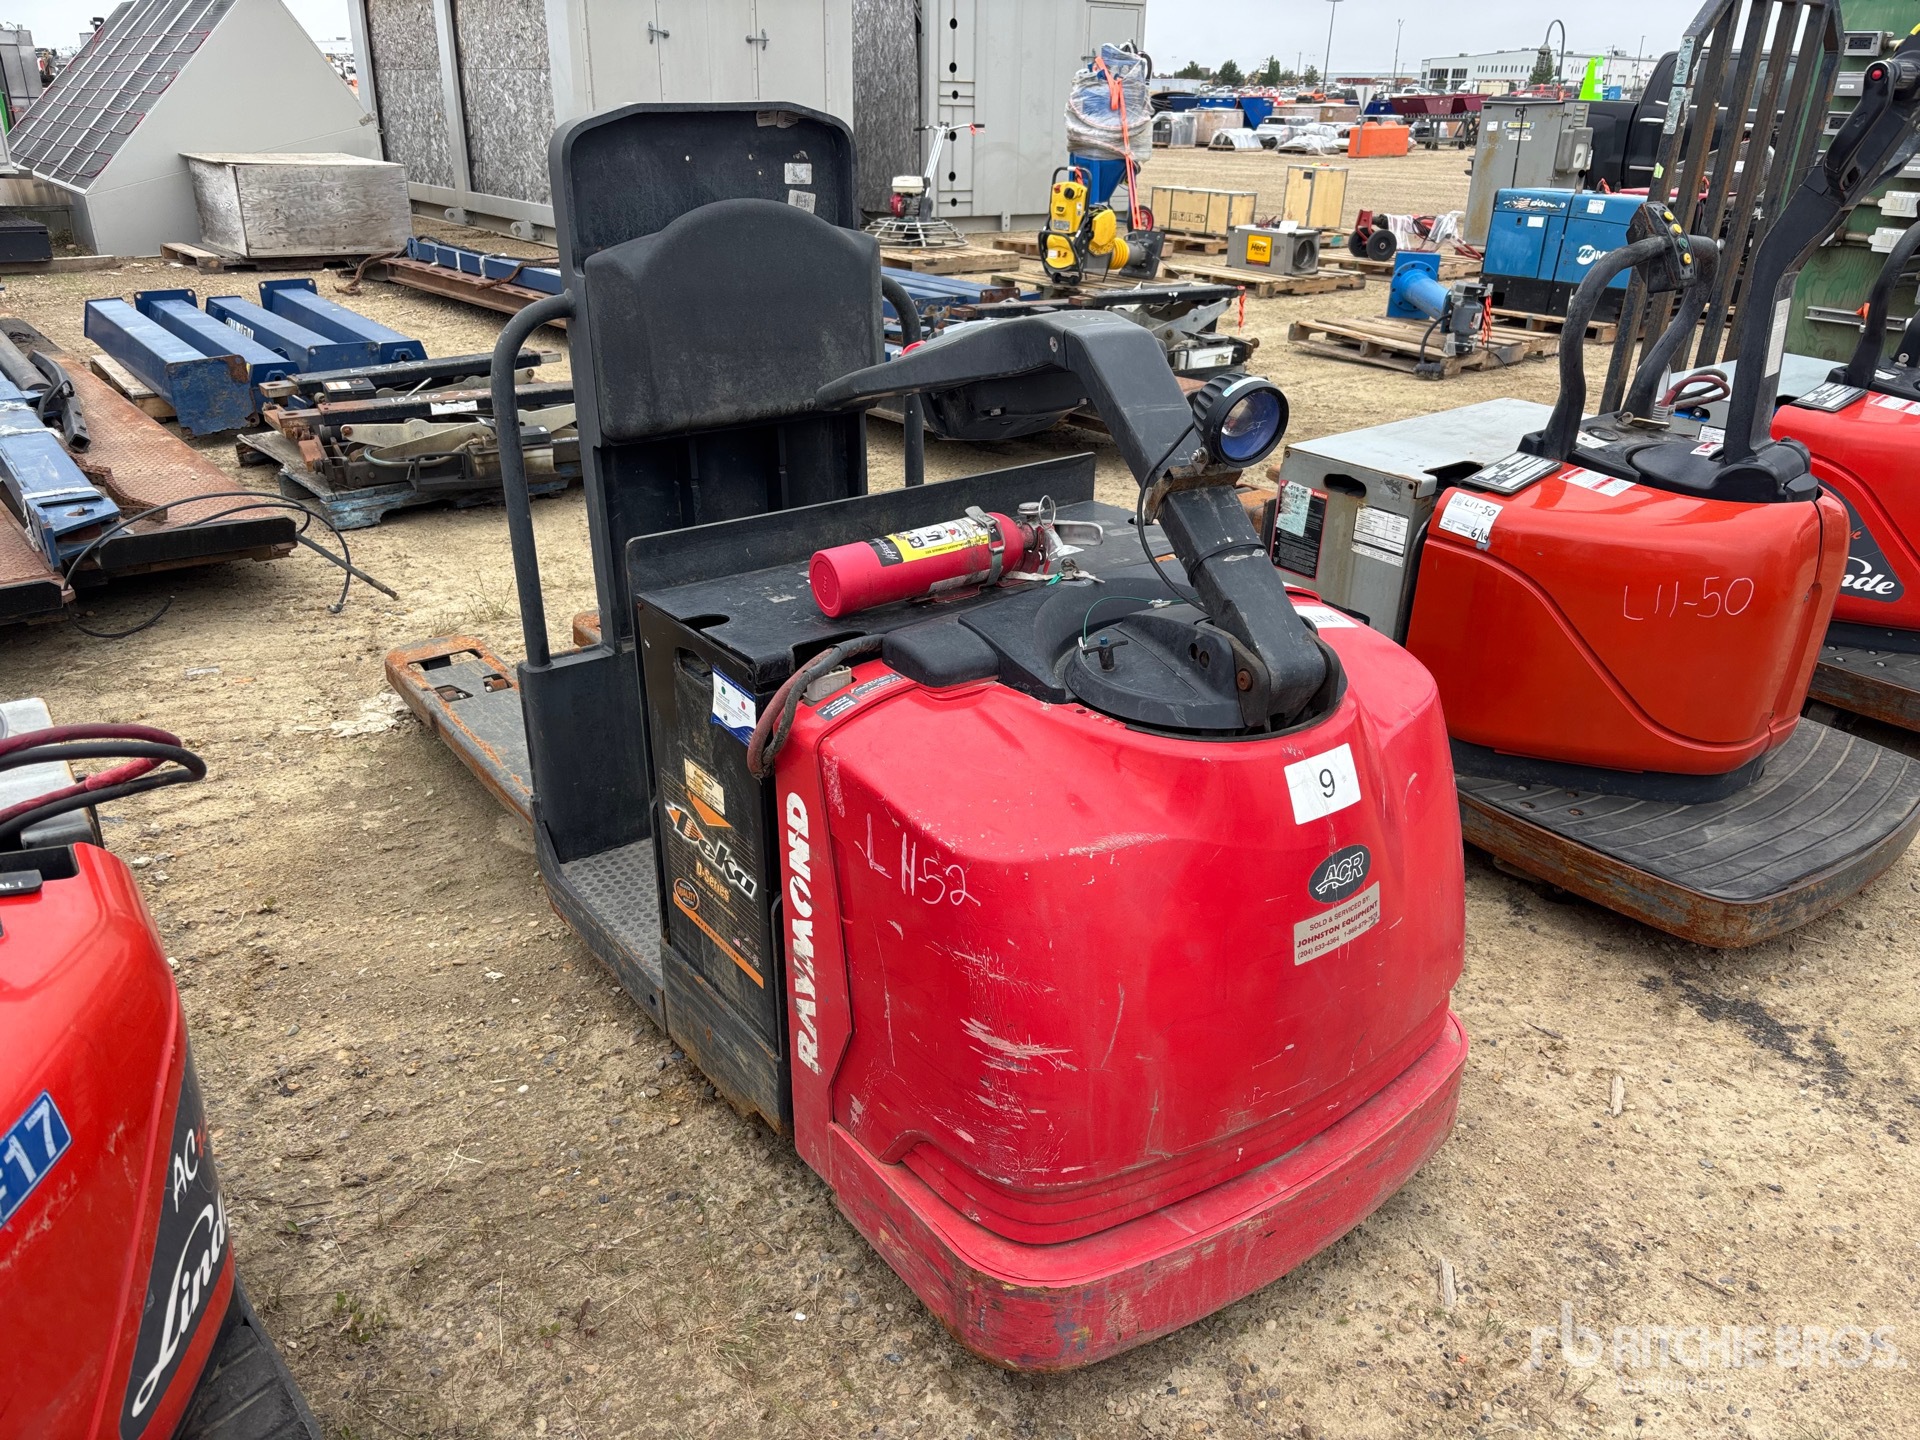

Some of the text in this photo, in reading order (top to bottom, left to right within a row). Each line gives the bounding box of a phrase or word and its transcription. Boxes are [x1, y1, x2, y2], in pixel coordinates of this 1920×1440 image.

[1250, 243, 1267, 253] Herc
[1464, 499, 1497, 517] L11-50
[1841, 556, 1896, 595] nde
[1319, 768, 1336, 798] 9
[665, 803, 757, 898] Deka
[1315, 851, 1364, 894] ACR
[786, 792, 823, 1076] RAYMOND
[1297, 900, 1378, 948] JOHNSTON EQUIPMENT
[1309, 918, 1328, 931] SOLD
[1328, 915, 1333, 923] &
[1334, 900, 1362, 920] SERVICED
[1297, 947, 1313, 960] (204)
[0, 1099, 58, 1199] 17
[131, 1191, 228, 1418] Lind
